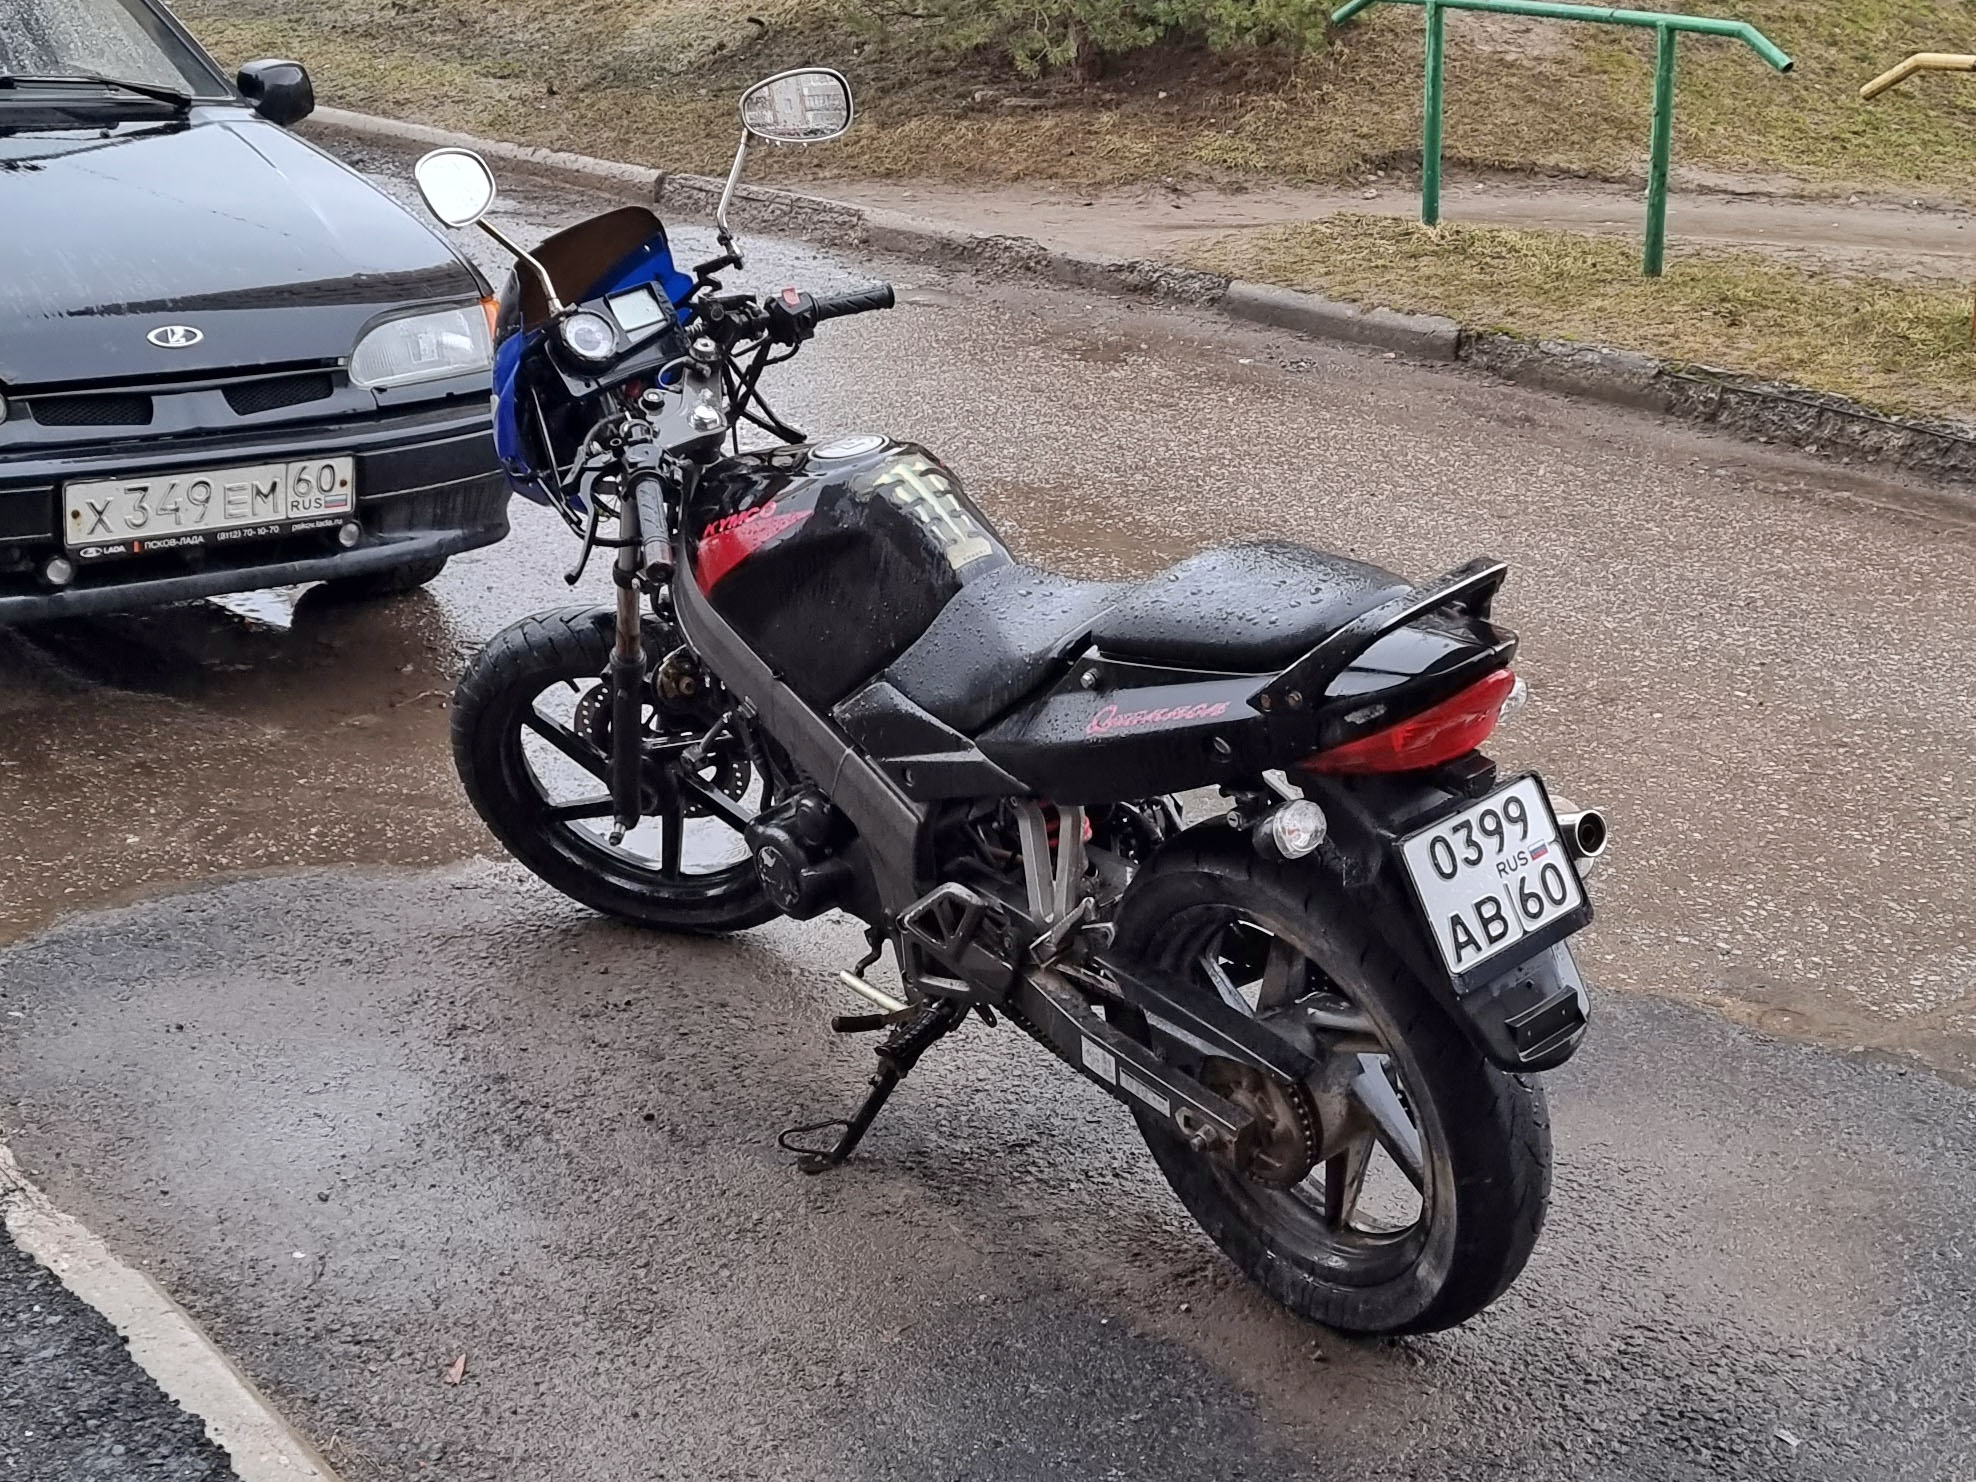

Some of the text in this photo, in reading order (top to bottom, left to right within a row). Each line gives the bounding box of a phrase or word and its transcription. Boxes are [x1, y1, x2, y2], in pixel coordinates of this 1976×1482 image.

[292, 463, 337, 498] 60
[291, 496, 323, 511] RUS
[242, 524, 280, 537] 70-10-70
[702, 501, 777, 538] KYMCO
[103, 545, 126, 555] LADA
[144, 535, 205, 550] ПСКОВ-ЛАДА
[1429, 796, 1529, 880] 0399
[1496, 850, 1529, 878] RUS
[1518, 862, 1567, 920] 60
